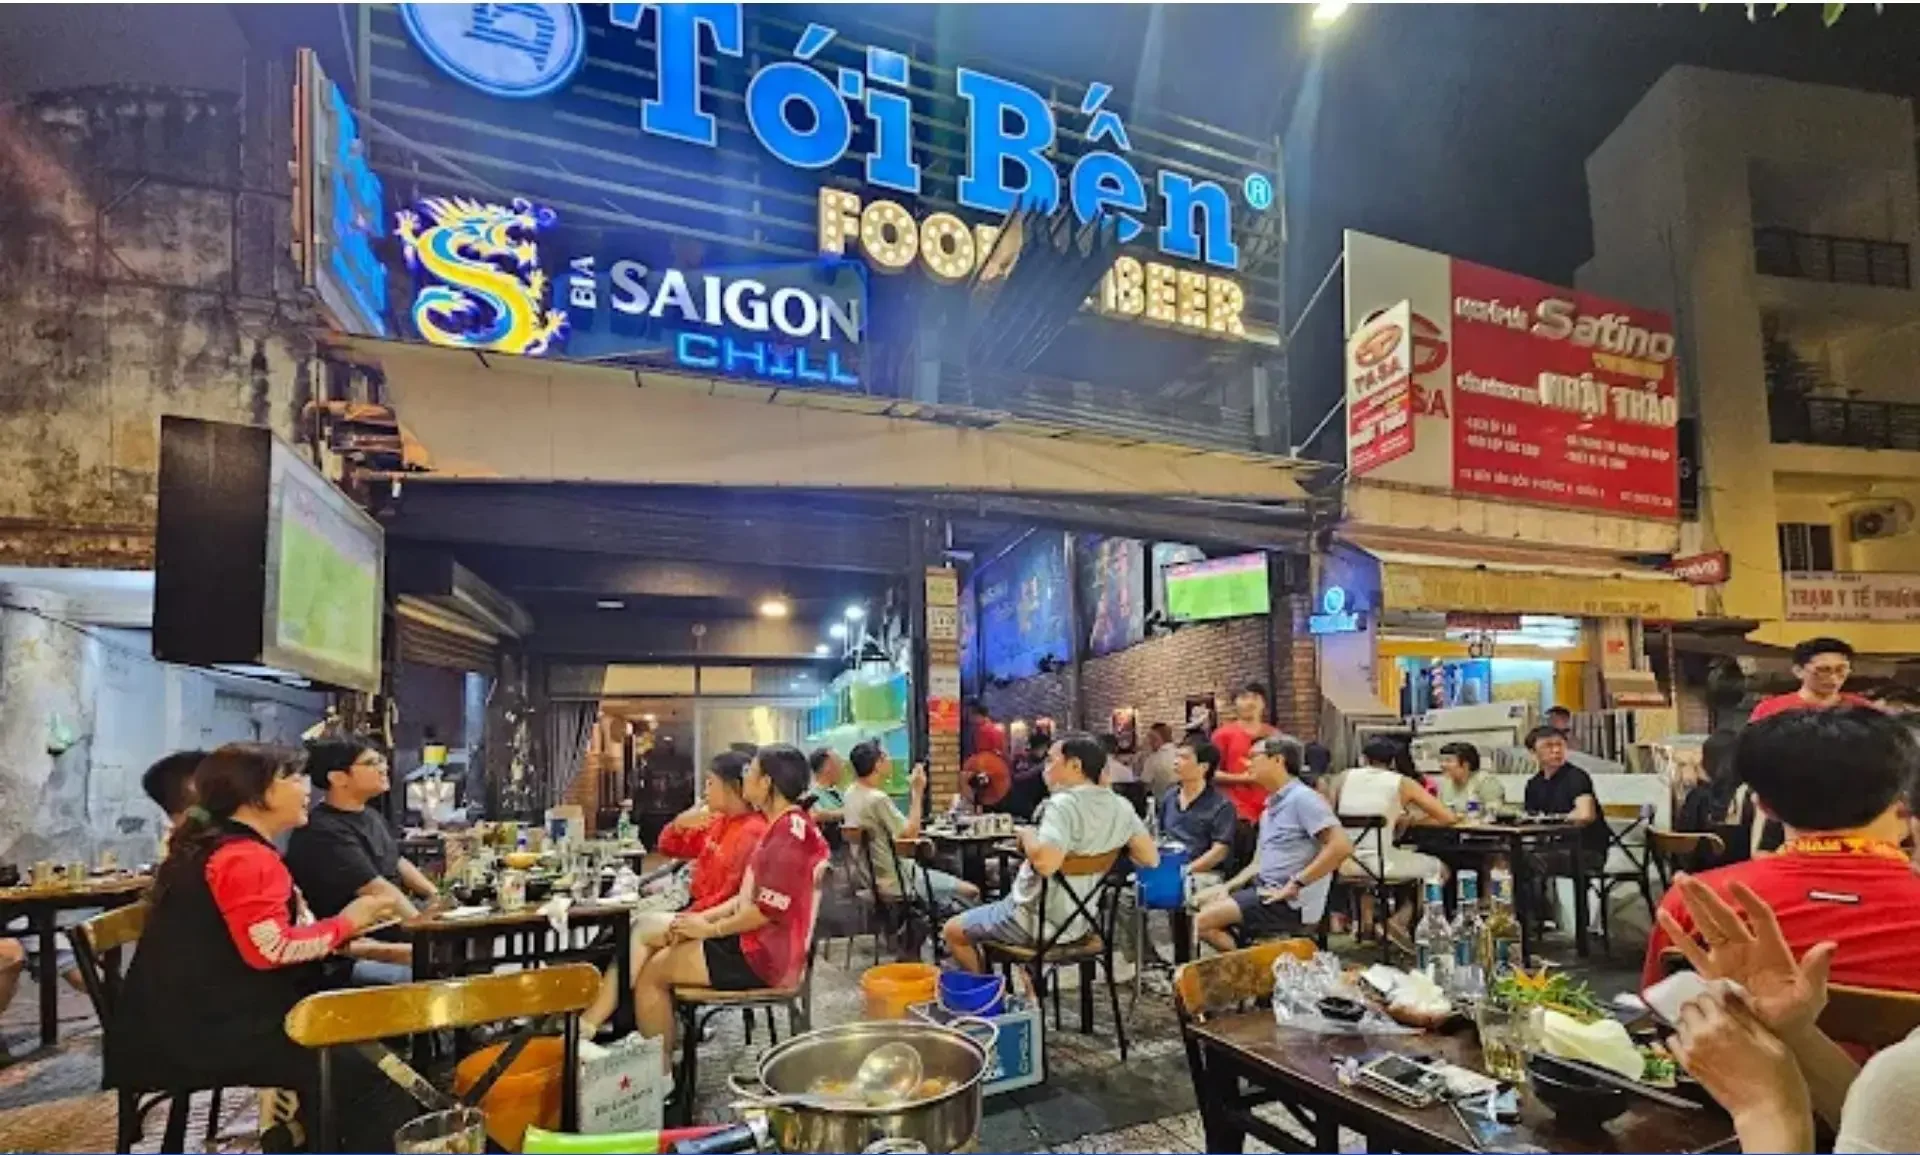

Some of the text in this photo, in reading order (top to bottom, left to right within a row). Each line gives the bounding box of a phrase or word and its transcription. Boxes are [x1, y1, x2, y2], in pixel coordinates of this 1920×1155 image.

[609, 3, 1239, 269] Tới Bến
[570, 256, 597, 309] BIA
[609, 258, 861, 345] SAIGON
[1113, 256, 1248, 336] BEER
[674, 330, 860, 386] CHILL
[1538, 372, 1609, 421] NHẬT
[1610, 380, 1679, 427] THẢO
[1790, 588, 1834, 611] TRẠM
[1837, 588, 1847, 608] Y
[1852, 584, 1872, 608] TẾ
